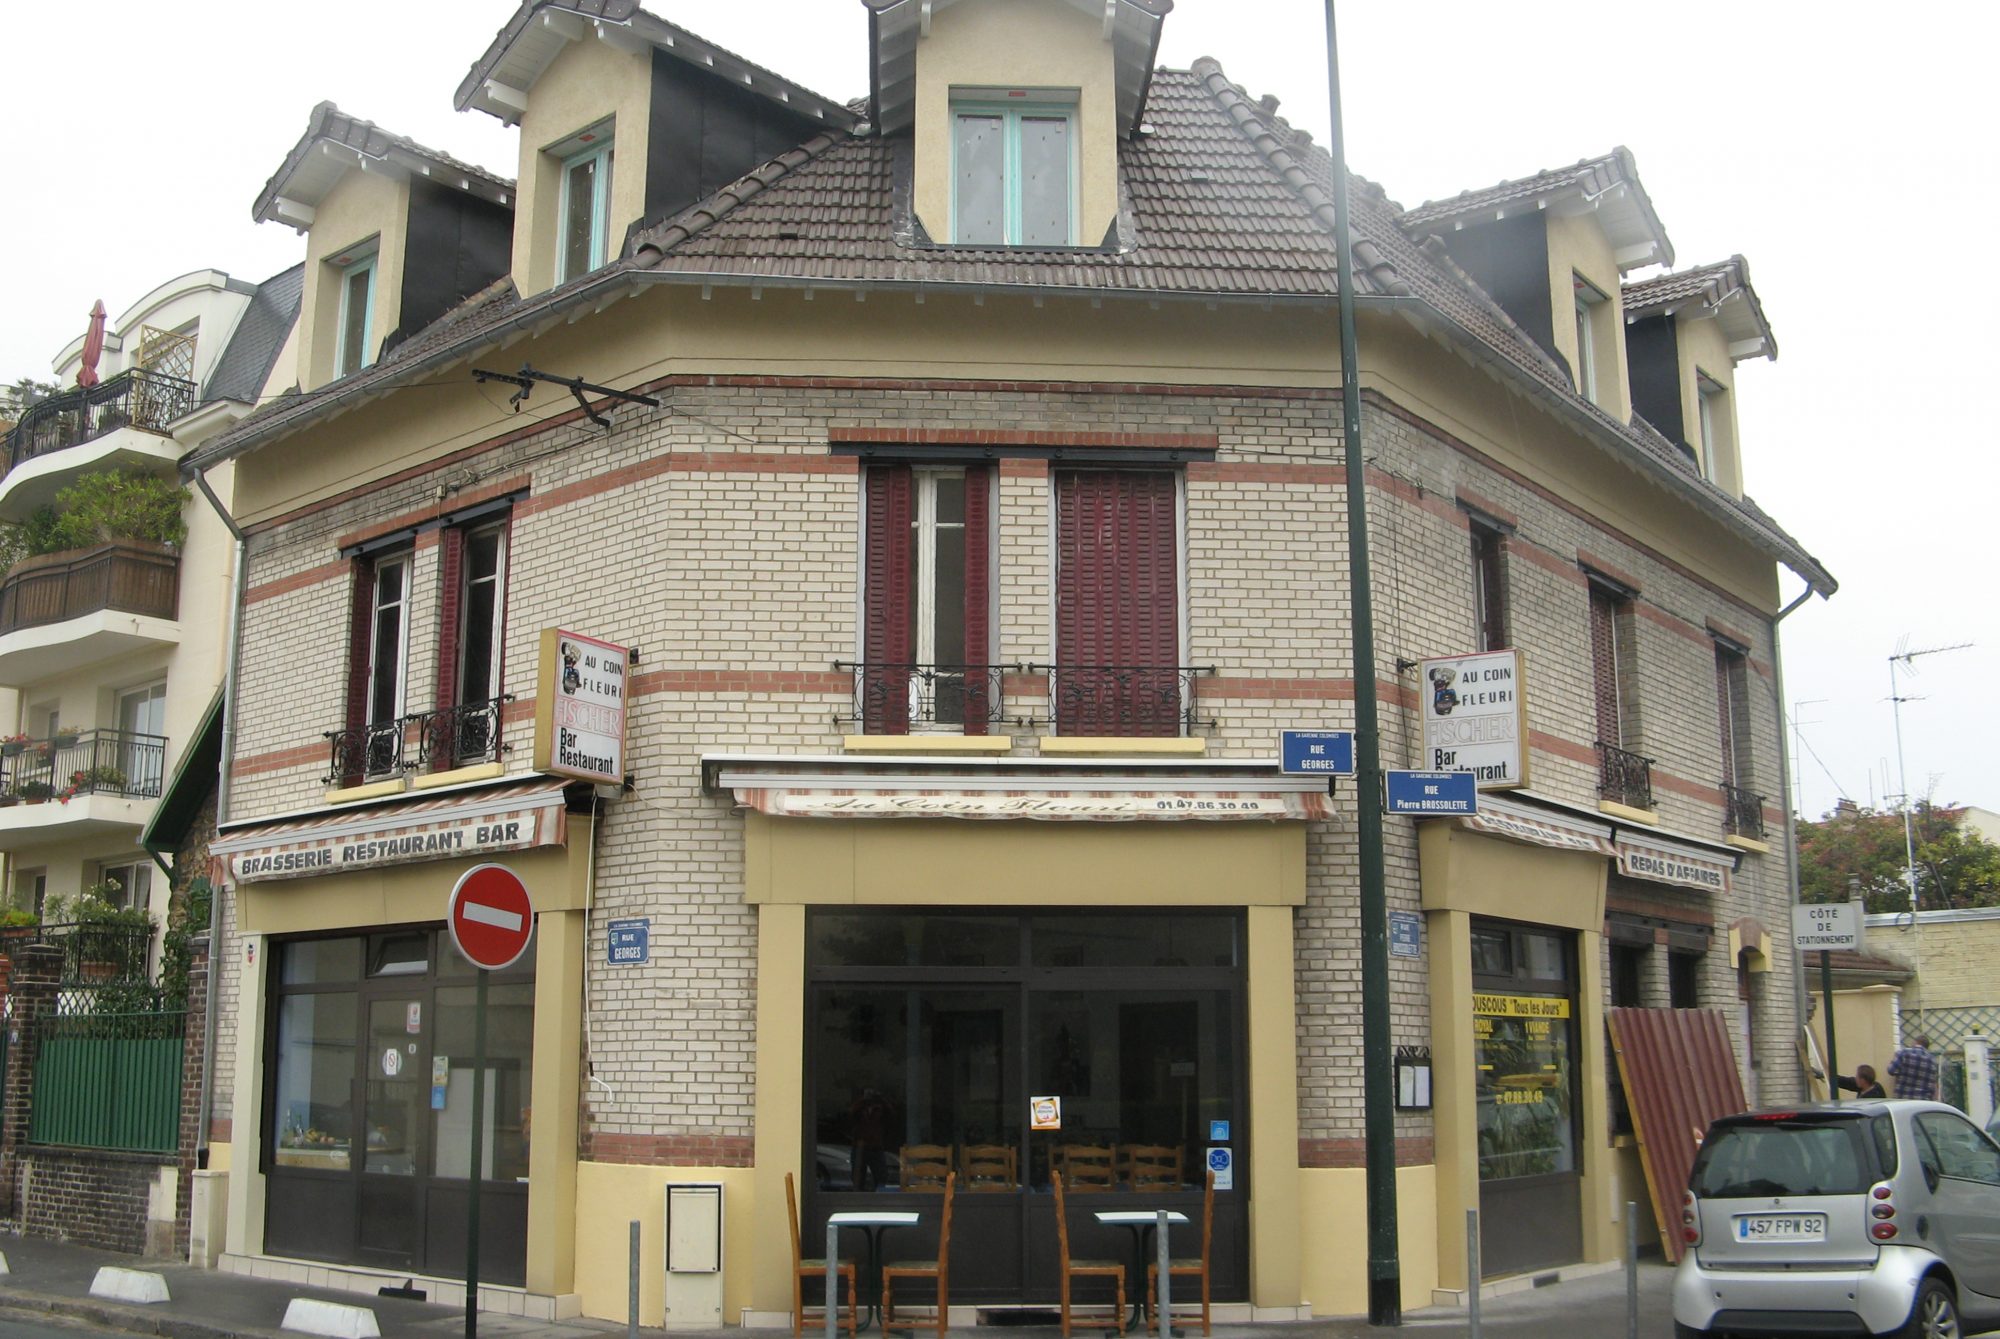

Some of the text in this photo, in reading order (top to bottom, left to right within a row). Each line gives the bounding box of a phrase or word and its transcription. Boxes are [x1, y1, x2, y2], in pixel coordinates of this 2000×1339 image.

[585, 655, 623, 676] AU COIN
[1462, 668, 1511, 684] AU COIN
[583, 678, 622, 698] FLEURI
[1462, 690, 1512, 706] FLEURI
[556, 699, 621, 736] FISCHER
[560, 727, 577, 749] Bar
[1425, 716, 1516, 746] FISCHER
[1310, 745, 1325, 754] RUE
[1435, 748, 1457, 766] Bar
[559, 746, 614, 775] Restaurant
[1301, 759, 1335, 769] GEORGES
[1424, 785, 1439, 795] RUE
[807, 798, 876, 809] Au
[890, 798, 984, 810] Coin
[999, 798, 1131, 811] Fleuri
[1397, 799, 1468, 810] Pierre BROSSOLETTE
[241, 822, 520, 875] BRASSERIE RESTAURANT BAR
[1631, 854, 1665, 876] REPAS
[1809, 908, 1838, 919] CÔTÉ
[1817, 922, 1832, 932] DE
[1797, 935, 1854, 945] STATIONNEMENT
[1530, 1000, 1540, 1015] les
[1749, 1219, 1821, 1234] 457 FPW 92
